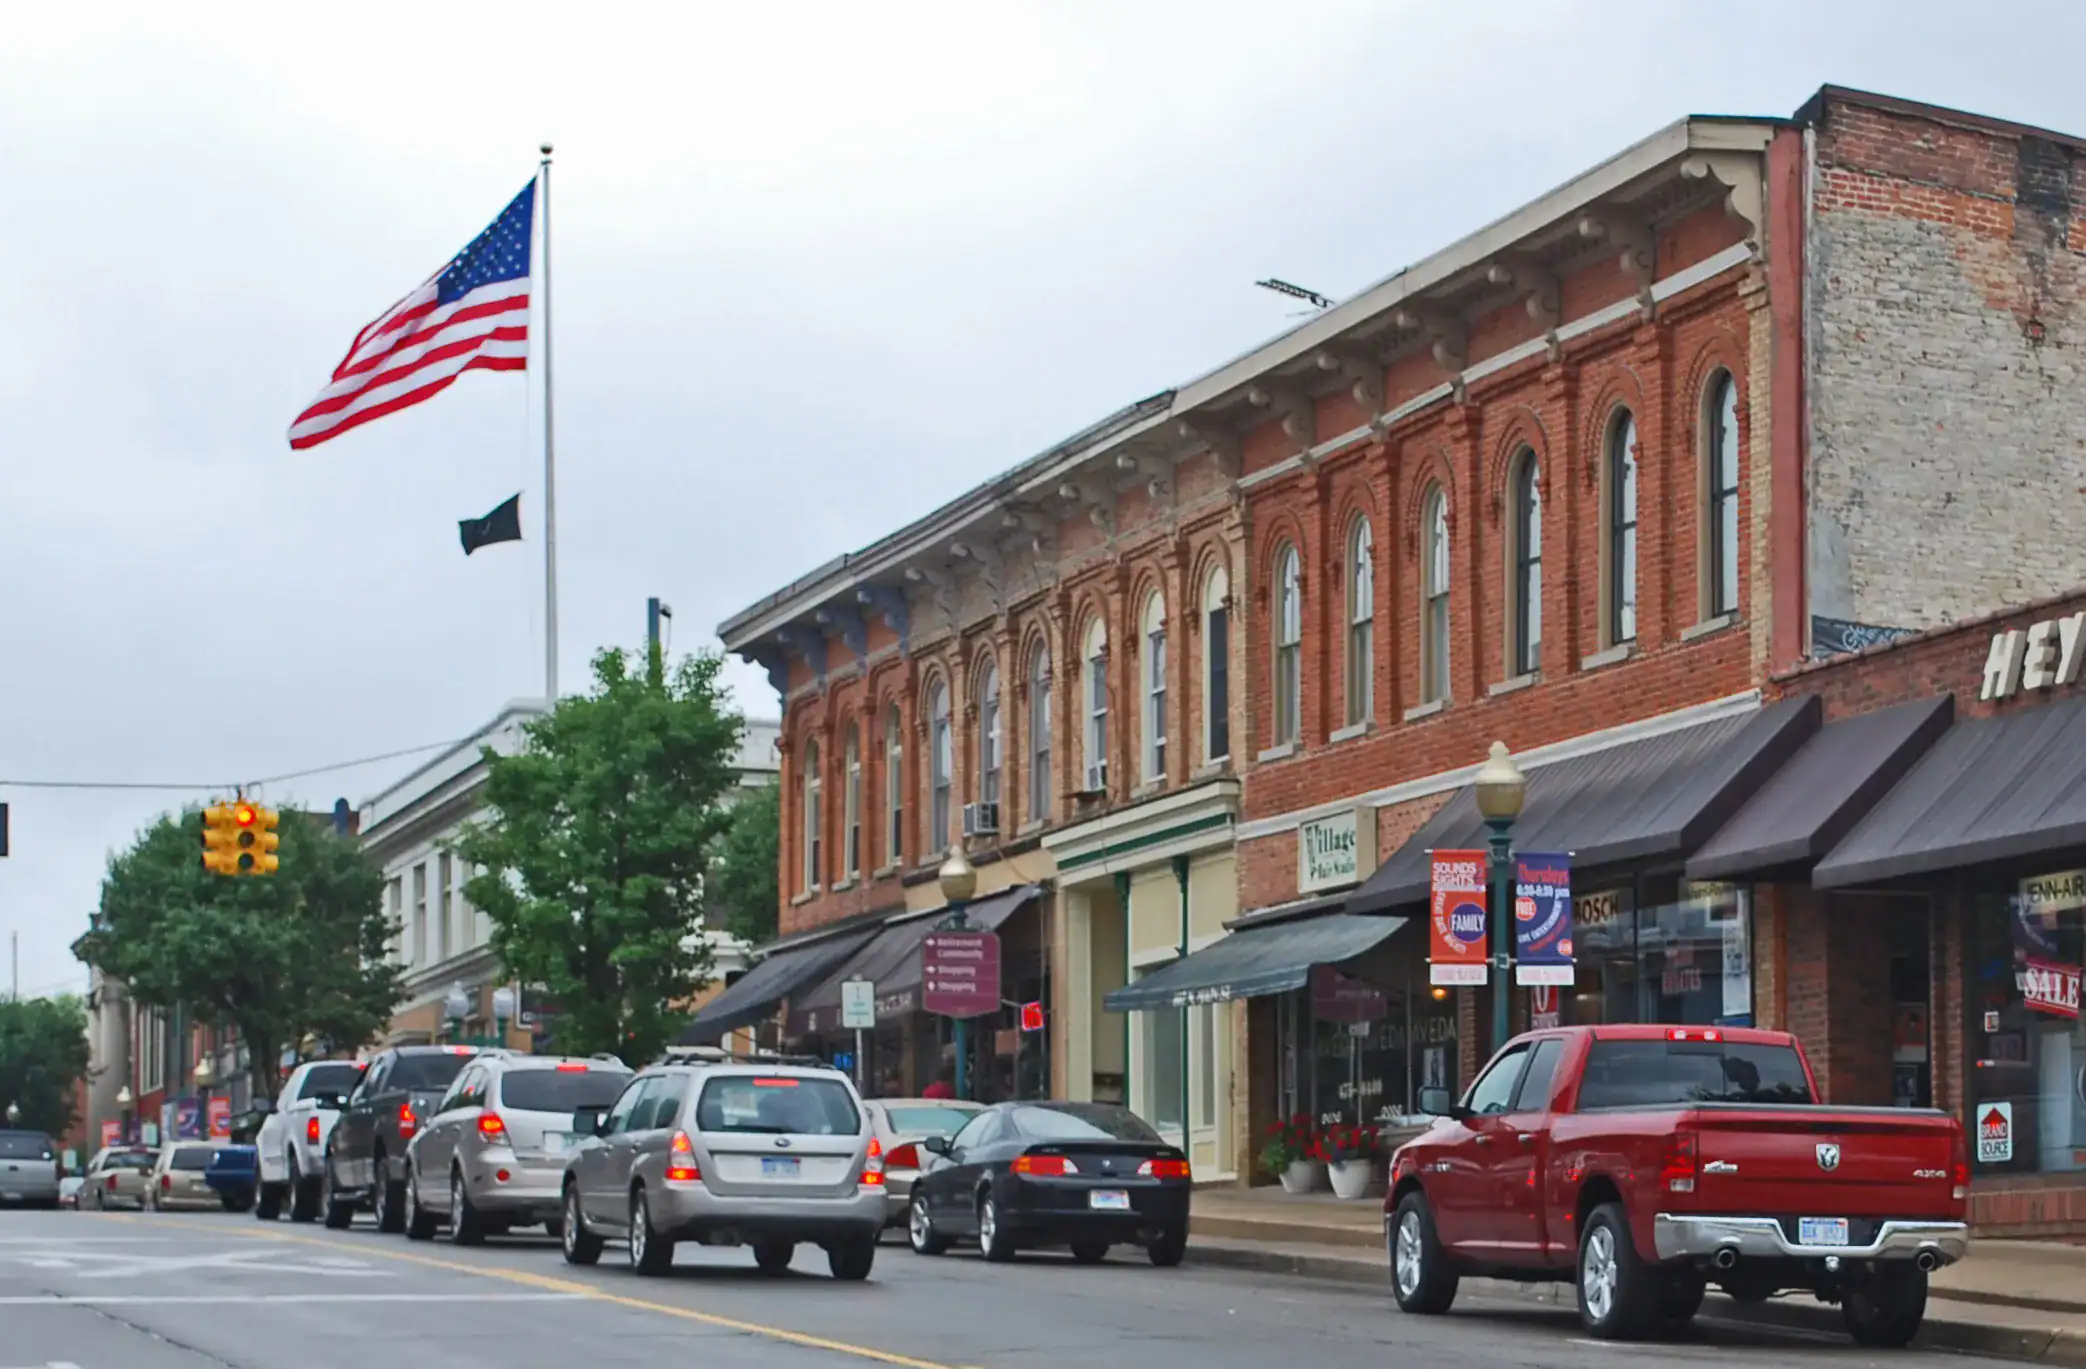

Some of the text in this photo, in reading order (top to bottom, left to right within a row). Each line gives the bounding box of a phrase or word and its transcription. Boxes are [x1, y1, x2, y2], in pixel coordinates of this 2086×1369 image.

[1305, 824, 1356, 878] Village
[1432, 862, 1477, 874] SOUNDS
[1432, 873, 1476, 886] SIGHTS
[1574, 895, 1618, 924] BOSCH
[1451, 913, 1486, 932] FAMILY
[937, 949, 983, 960] Community
[938, 966, 976, 977] Shopping
[938, 982, 976, 993] Shopping
[2024, 967, 2080, 1009] SALE
[1981, 1122, 2007, 1138] BRAND
[1981, 1140, 2008, 1157] SOURCE
